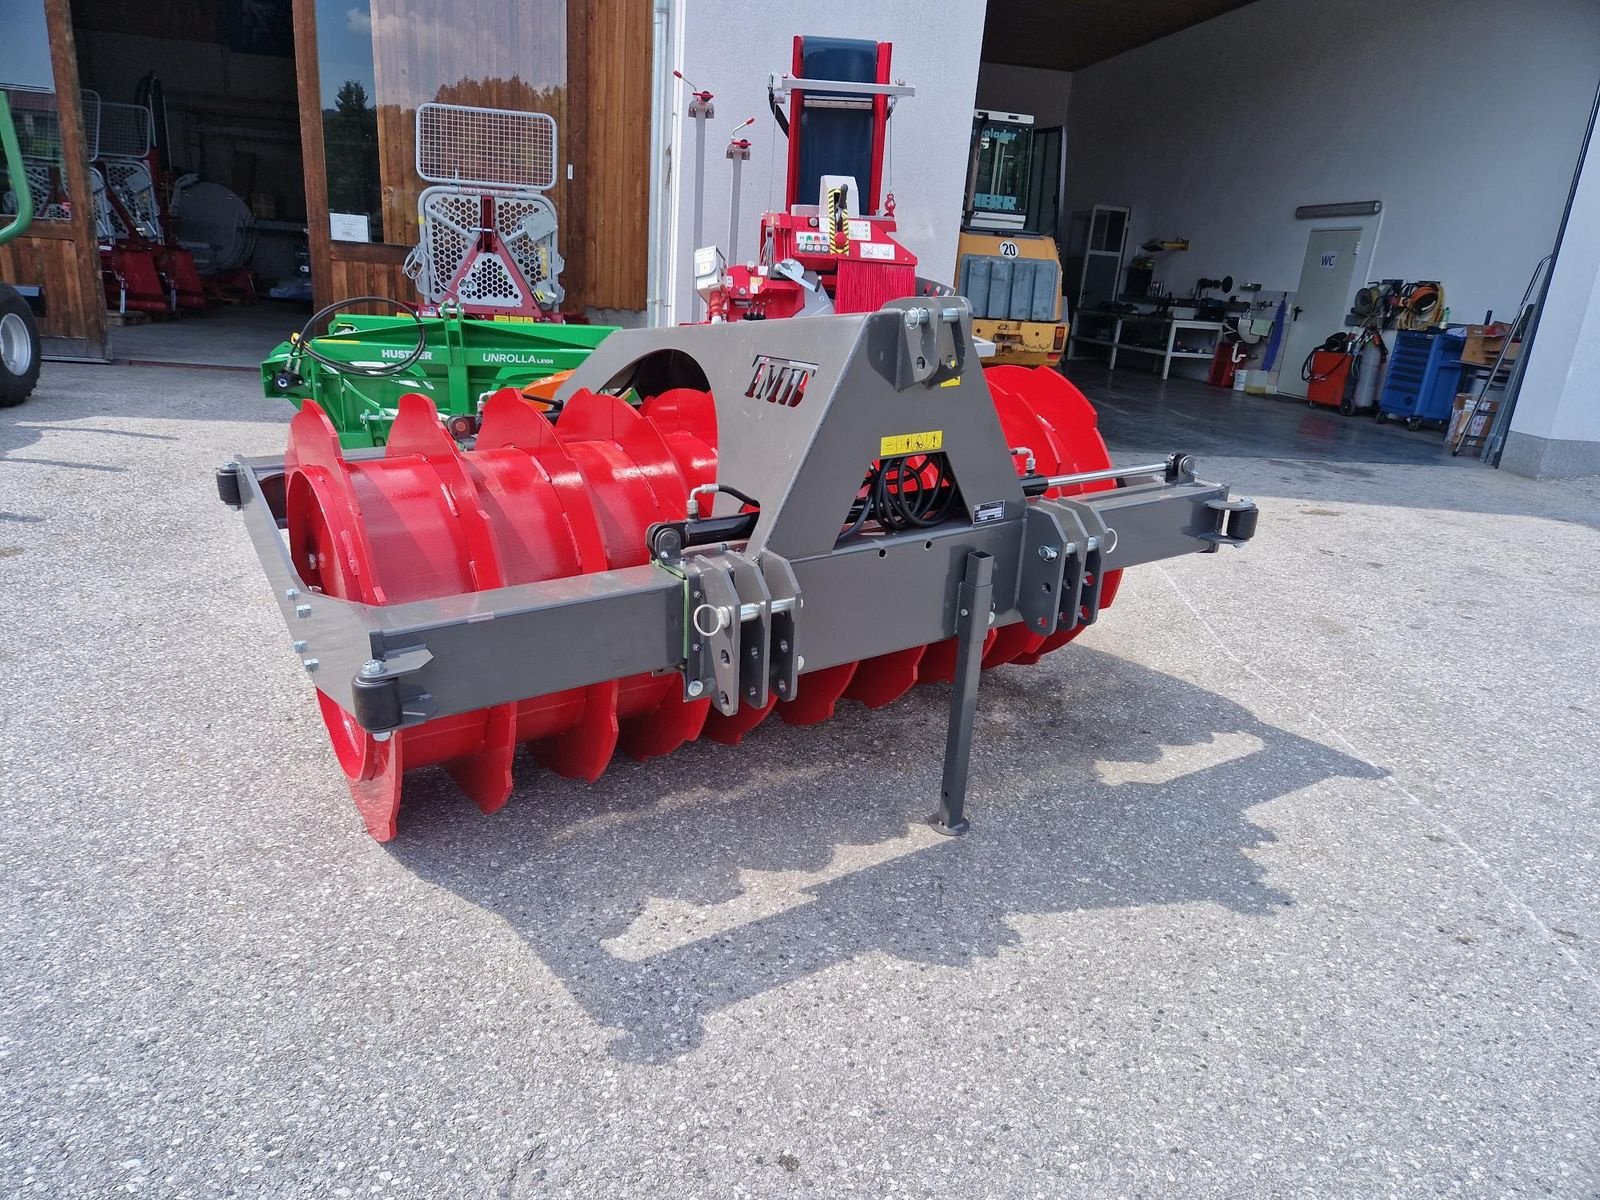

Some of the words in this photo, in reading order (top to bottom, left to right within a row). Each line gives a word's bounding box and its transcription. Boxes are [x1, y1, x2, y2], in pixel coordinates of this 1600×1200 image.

[1002, 243, 1016, 256] 20
[1321, 255, 1335, 266] WC
[381, 349, 433, 360] HUSTER
[482, 353, 536, 364] UNROLLA
